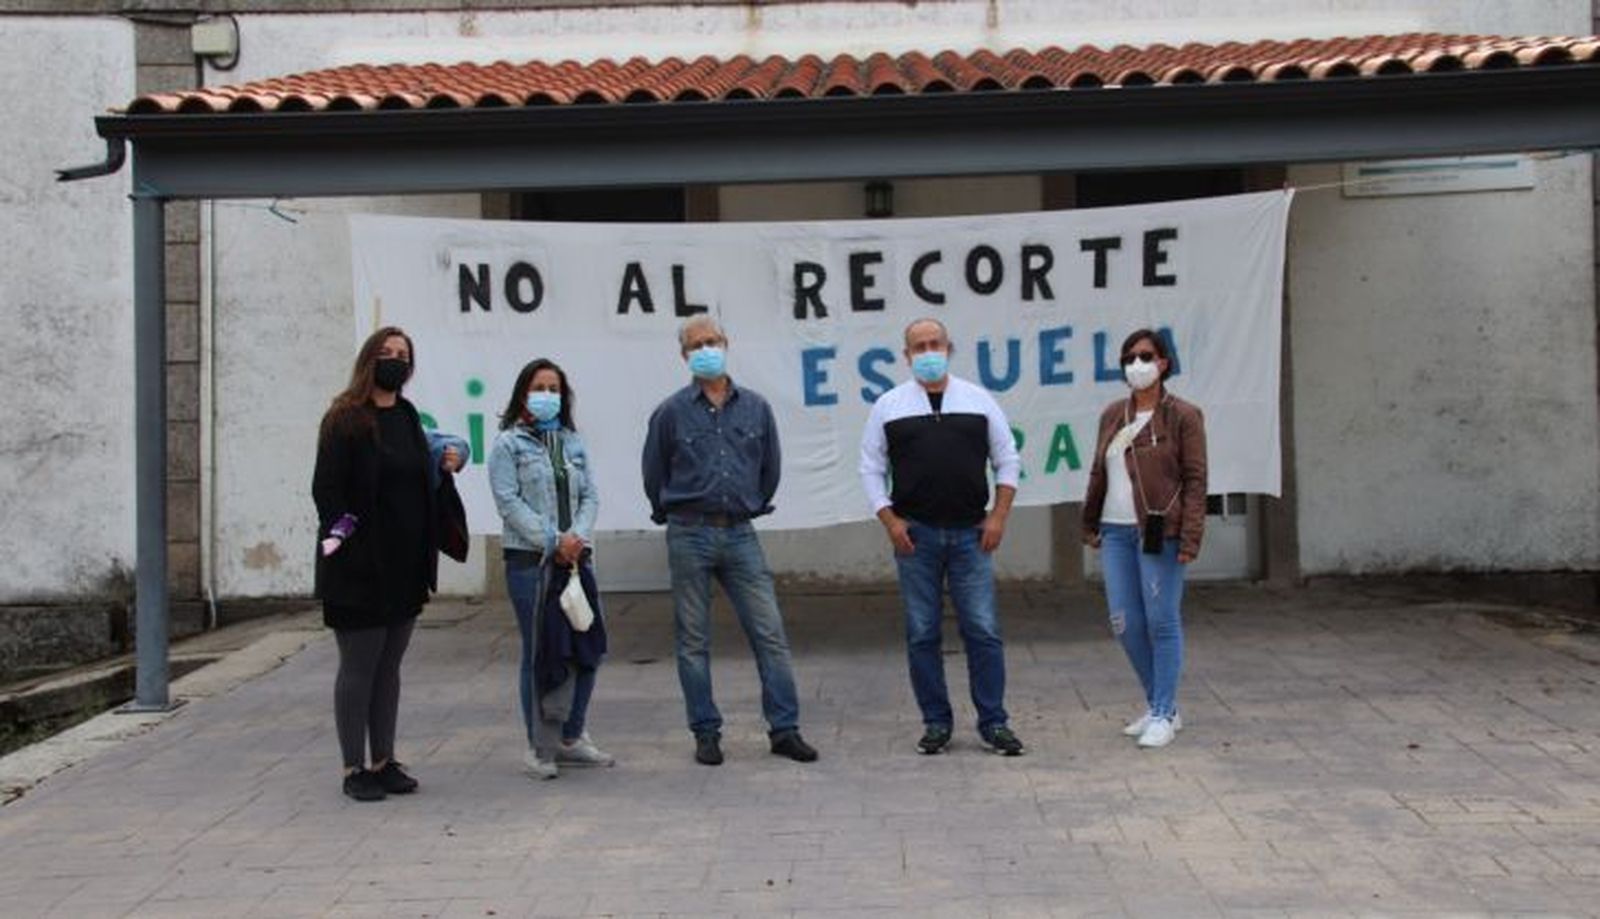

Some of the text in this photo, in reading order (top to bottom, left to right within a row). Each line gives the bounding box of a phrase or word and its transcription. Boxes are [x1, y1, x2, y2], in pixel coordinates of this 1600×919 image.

[458, 228, 1179, 320] NO AL RECORTE
[801, 326, 1181, 407] ESUEL
[420, 378, 484, 464] i
